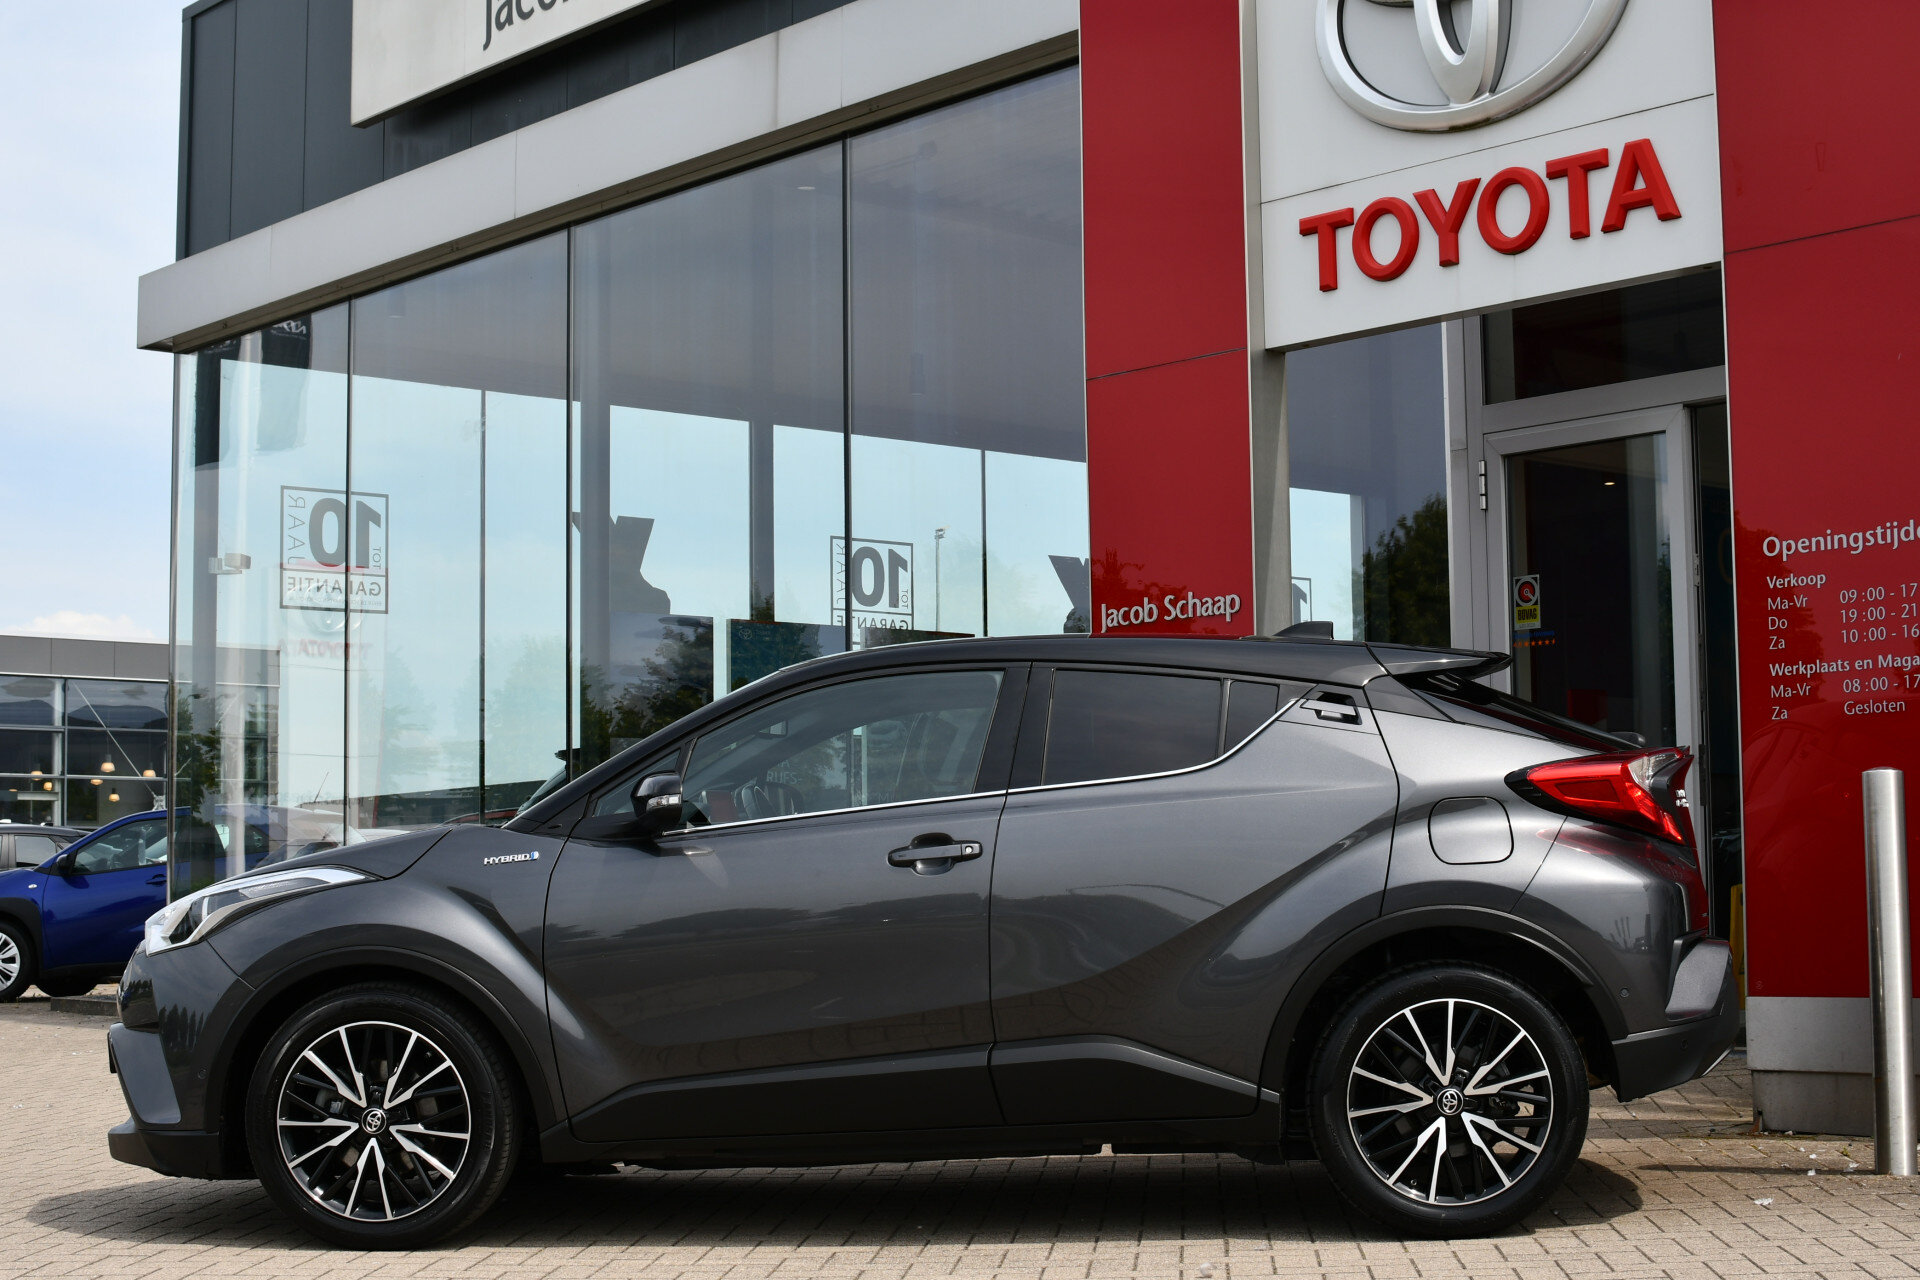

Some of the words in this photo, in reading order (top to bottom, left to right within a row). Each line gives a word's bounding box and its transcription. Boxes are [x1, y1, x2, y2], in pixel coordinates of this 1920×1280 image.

[482, 0, 570, 51] Jac
[1298, 137, 1682, 292] TOYOTA
[1767, 574, 1826, 589] Verkoop
[1768, 594, 1808, 610] Ma-Vr
[1900, 583, 1918, 597] 17
[1101, 596, 1159, 633] Jacob
[1163, 591, 1242, 623] Schaap
[1769, 617, 1788, 630] Do
[1901, 603, 1917, 618] 21
[1769, 637, 1785, 650] Za
[1902, 624, 1920, 638] 16
[1770, 659, 1850, 678] Werkplaats
[1855, 656, 1872, 670] en
[1771, 683, 1811, 698] Ma-Vr
[1772, 706, 1788, 720] Za
[1844, 700, 1906, 715] Gesloten
[483, 853, 530, 865] HYBRID
